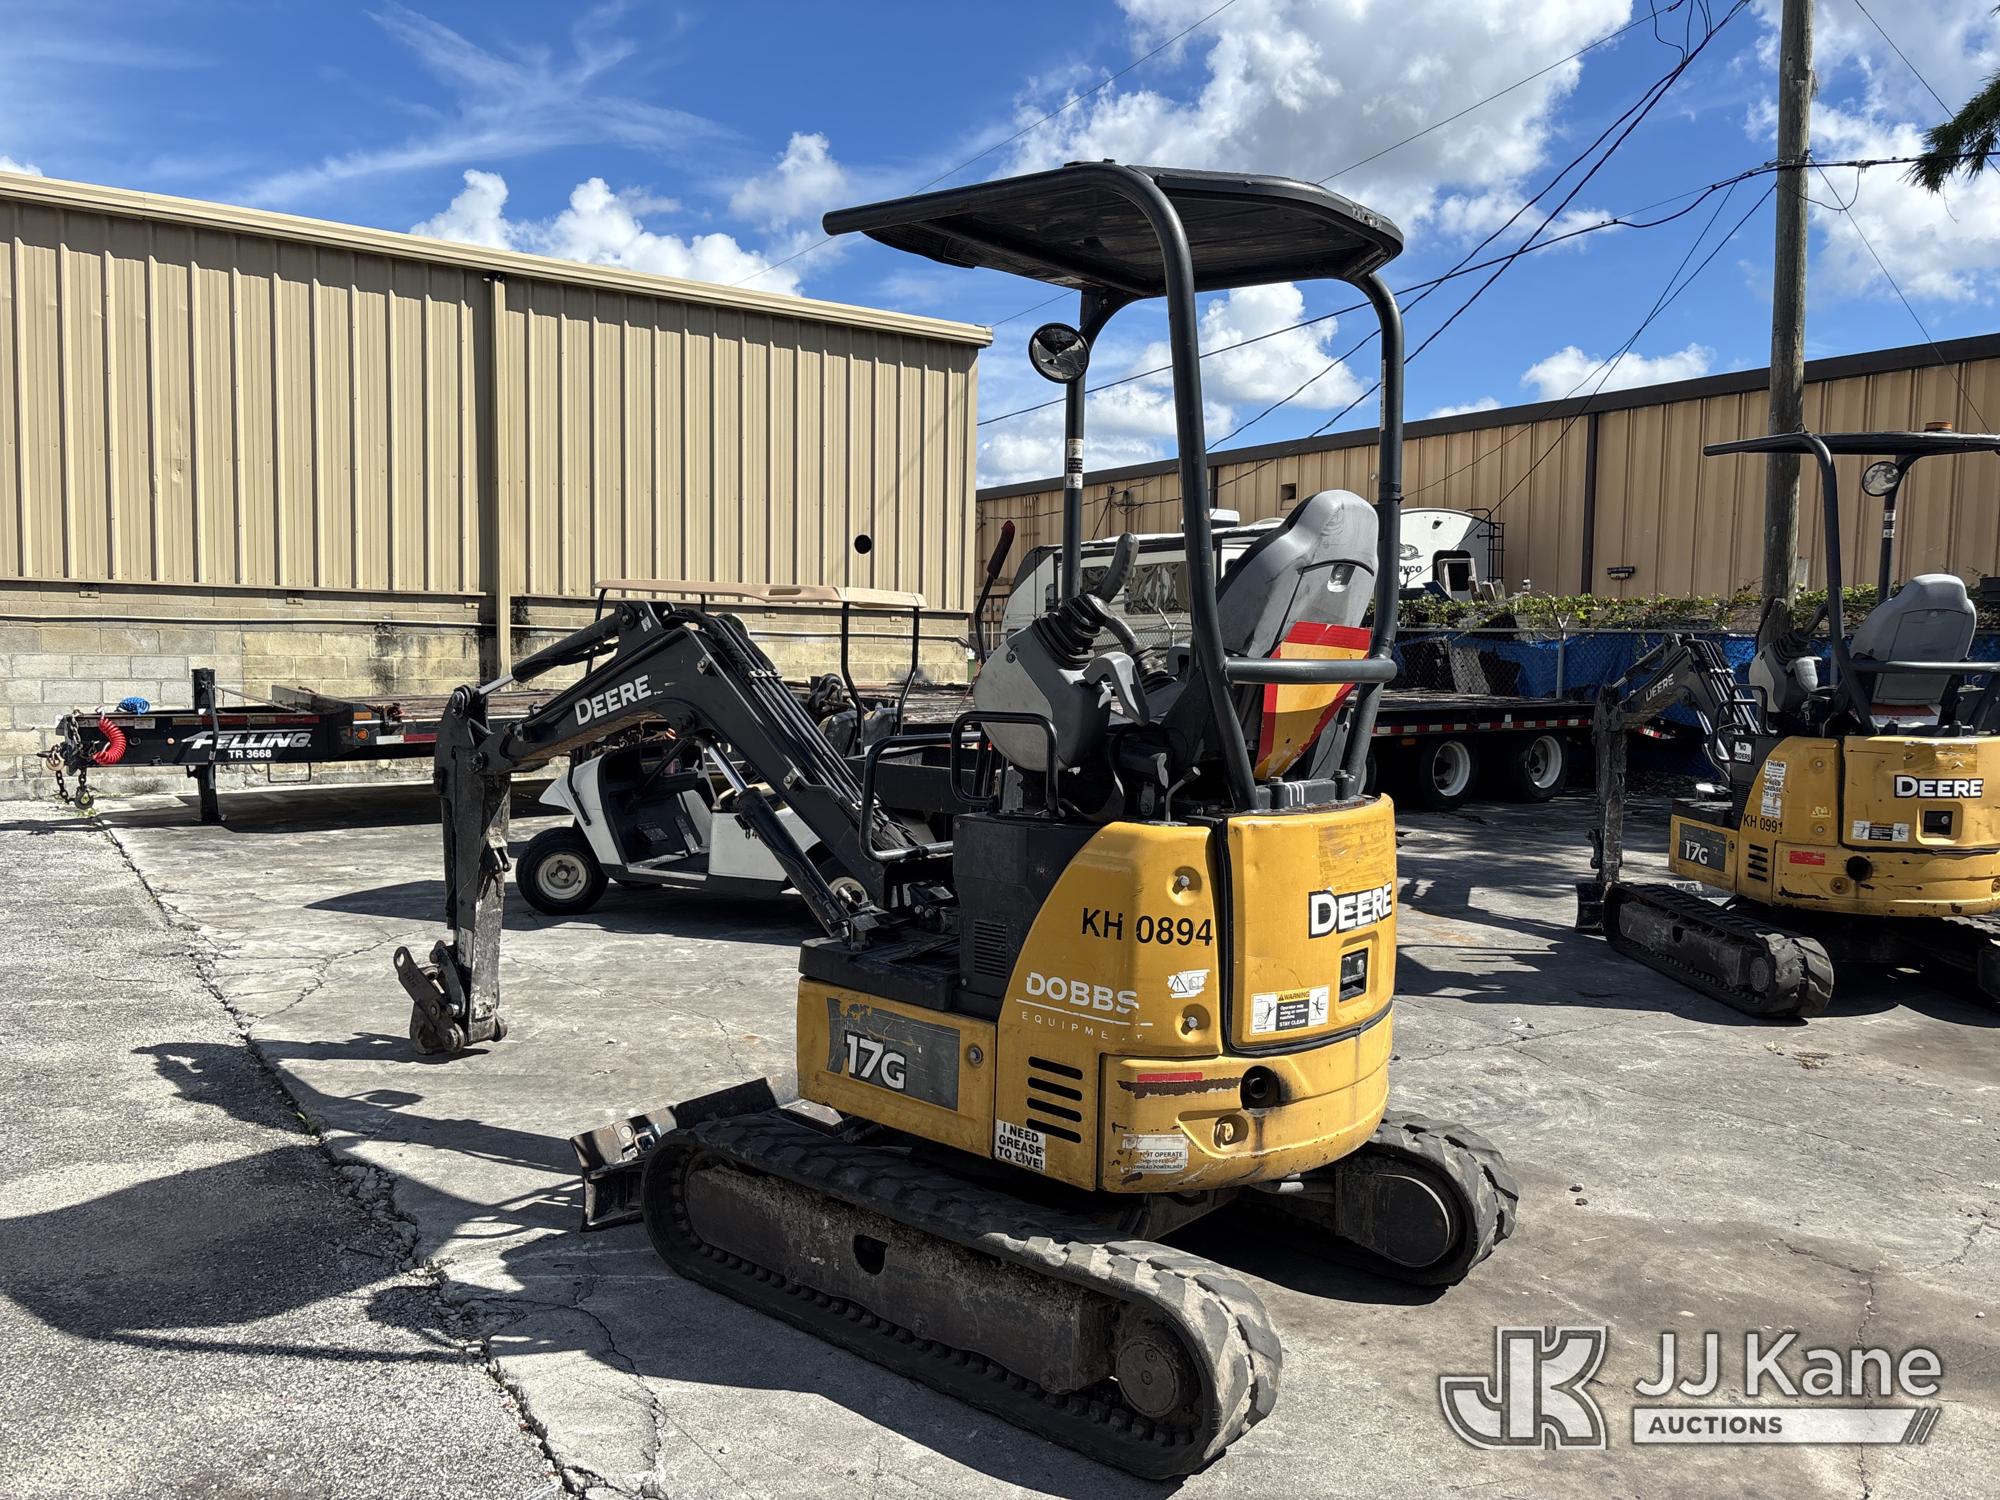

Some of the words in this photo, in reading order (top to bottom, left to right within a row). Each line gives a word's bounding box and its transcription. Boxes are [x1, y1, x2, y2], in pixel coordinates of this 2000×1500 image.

[574, 674, 652, 725] DEERE
[181, 728, 314, 749] FELLING
[228, 750, 243, 759] TR
[246, 749, 272, 759] 3668
[1894, 775, 1984, 798] DEERE
[1743, 814, 1757, 829] KH
[1685, 840, 1709, 865] 17G
[1308, 881, 1393, 939] DEERE
[1081, 908, 1124, 941] KH
[1135, 915, 1213, 946] 0894
[1026, 972, 1139, 1014] DOBBS
[1284, 991, 1310, 1001] WARNING
[1290, 1018, 1306, 1026] CLEAR
[846, 1034, 906, 1089] 17G
[1003, 1123, 1007, 1133] I
[1010, 1125, 1039, 1143] NEED
[999, 1134, 1043, 1157] GREASE
[997, 1145, 1012, 1159] TO
[1015, 1152, 1043, 1170] LIVE!
